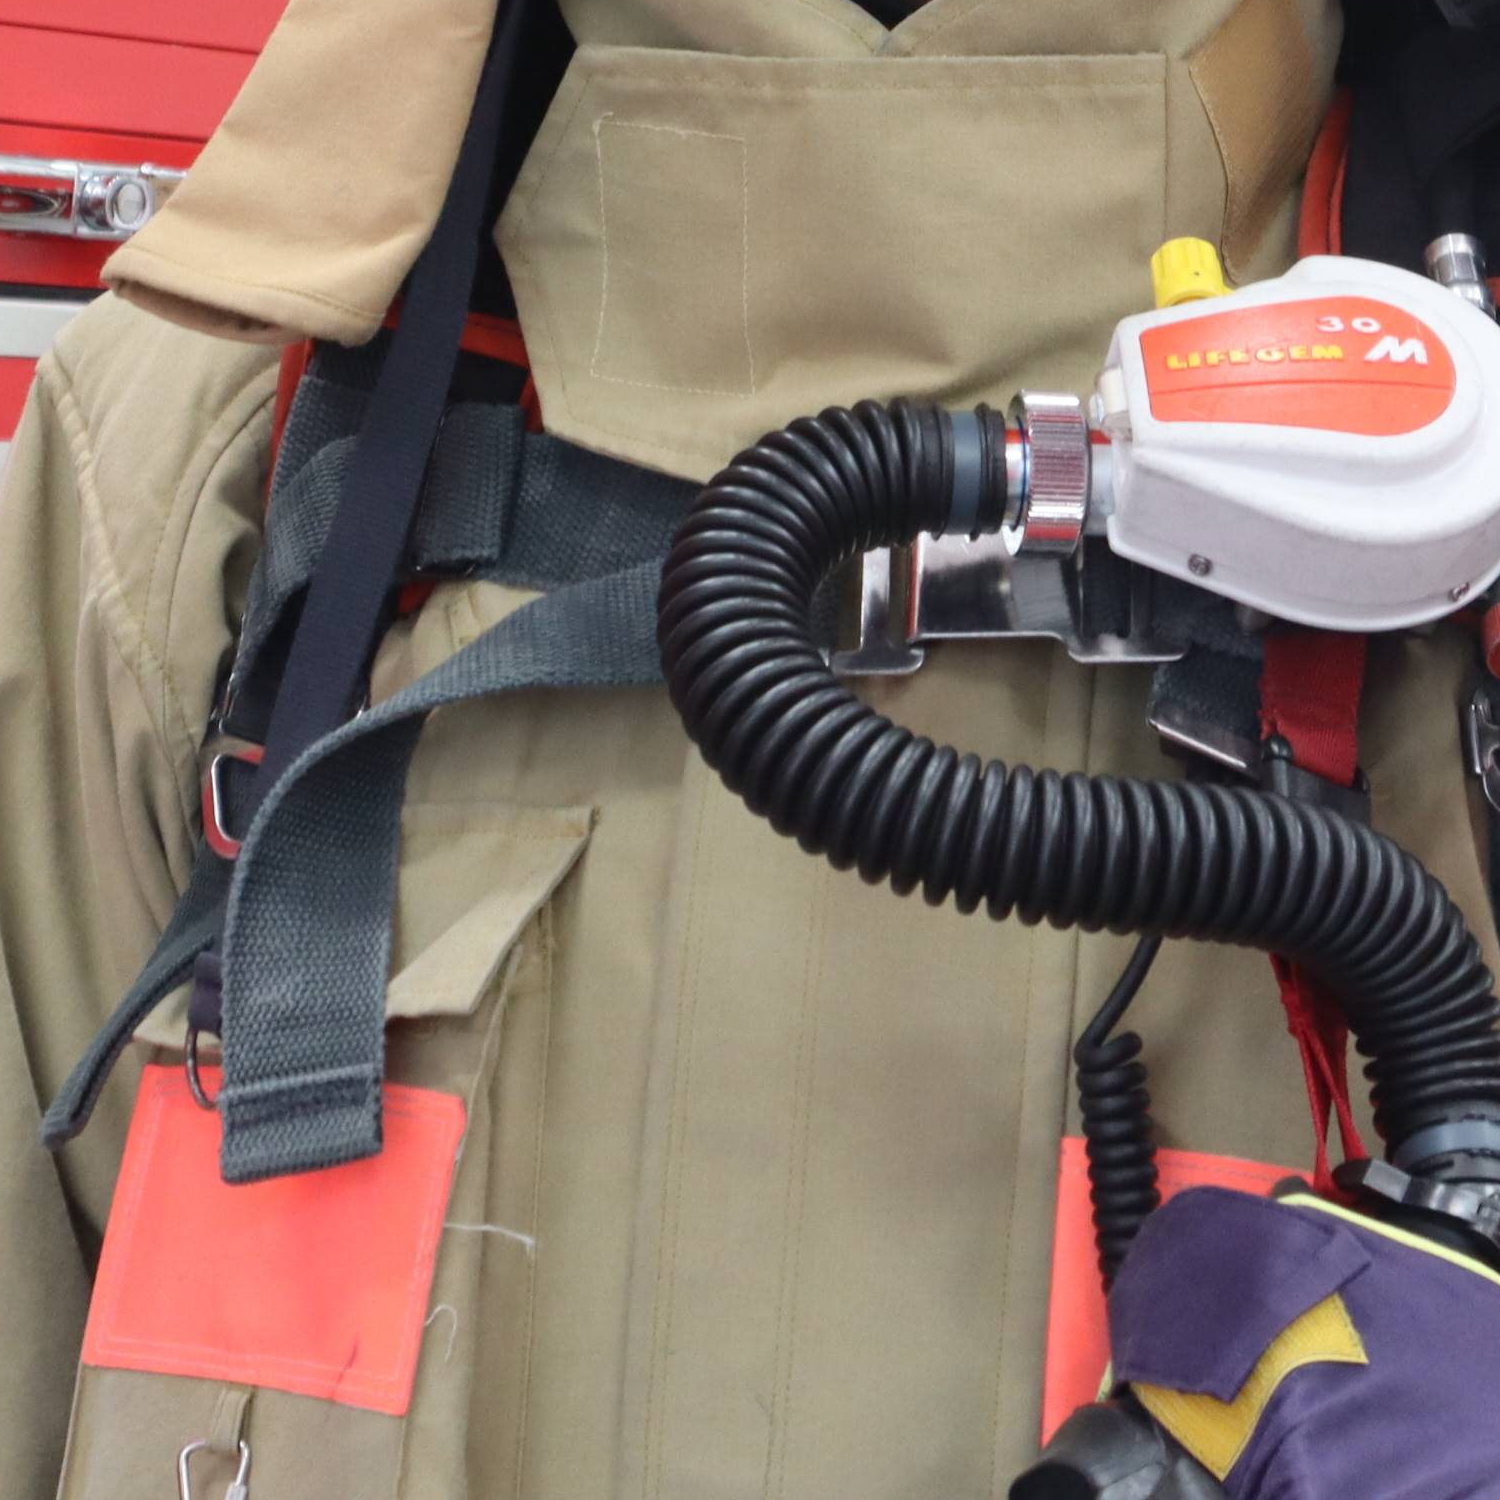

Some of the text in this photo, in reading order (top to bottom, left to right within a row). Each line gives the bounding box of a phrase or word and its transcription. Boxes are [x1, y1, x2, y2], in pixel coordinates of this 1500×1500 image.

[1317, 316, 1381, 333] 30
[1165, 335, 1428, 371] LIFEGEM M
